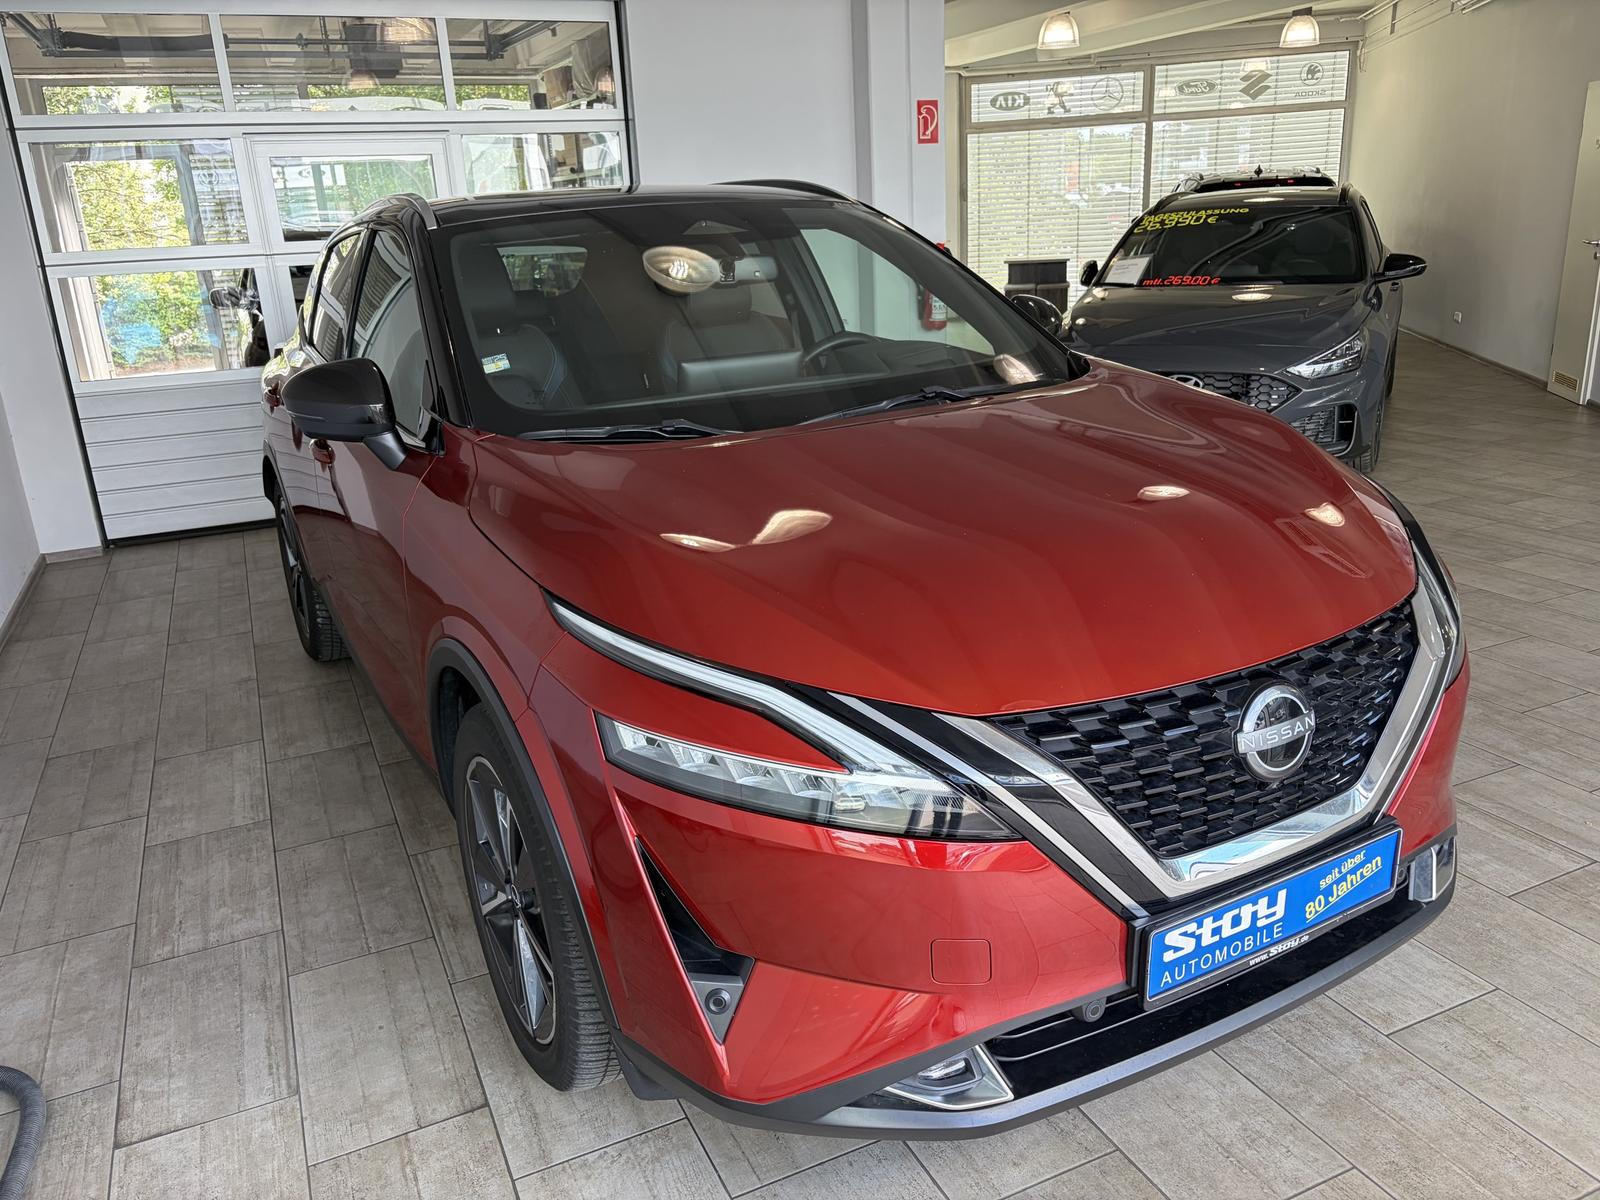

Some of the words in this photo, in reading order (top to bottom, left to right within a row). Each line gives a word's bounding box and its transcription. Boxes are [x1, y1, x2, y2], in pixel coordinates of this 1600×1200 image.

[1142, 207, 1250, 224] TAGESZULASSUNG
[1241, 714, 1315, 750] NISSAN
[1305, 895, 1325, 919] 80
[1328, 855, 1382, 903] Jahren
[1319, 869, 1340, 888] seit
[1340, 850, 1366, 875] über
[1163, 888, 1288, 963] Stoy
[1160, 922, 1284, 988] AUTOMOBILE
